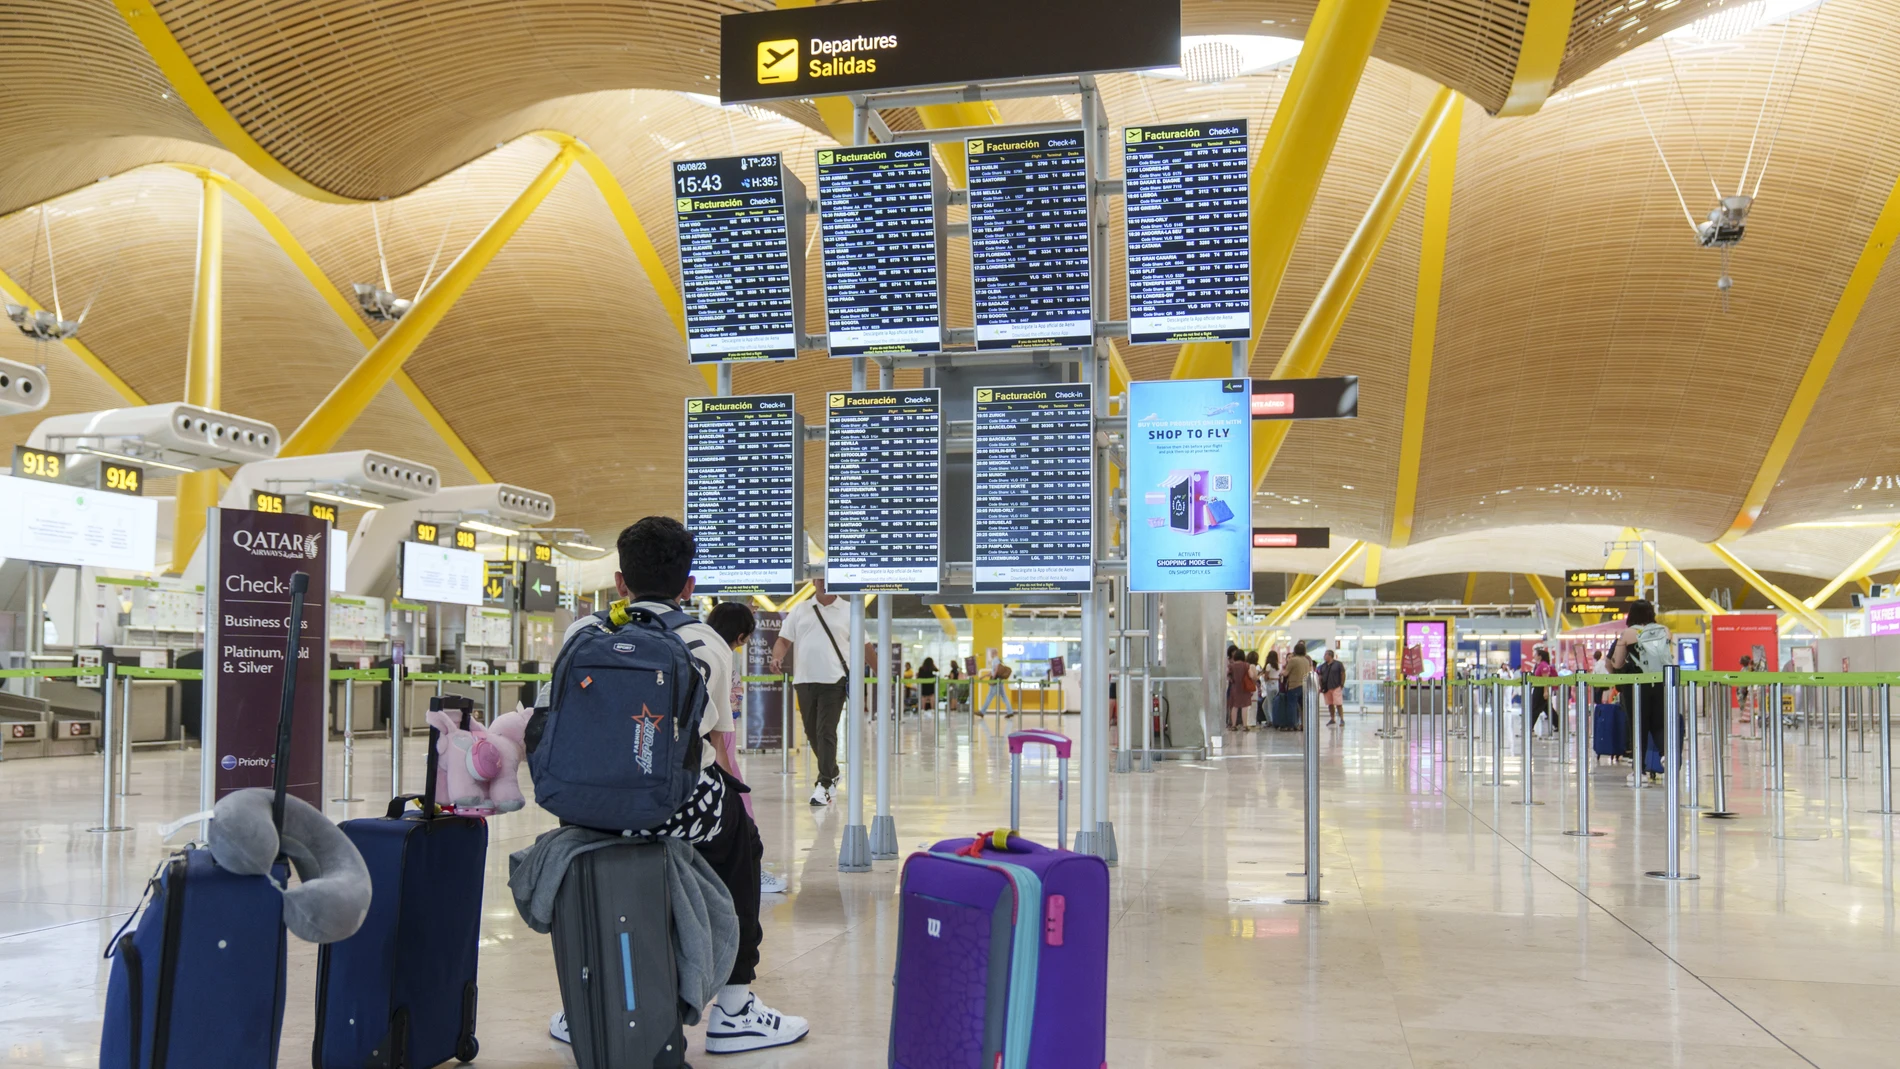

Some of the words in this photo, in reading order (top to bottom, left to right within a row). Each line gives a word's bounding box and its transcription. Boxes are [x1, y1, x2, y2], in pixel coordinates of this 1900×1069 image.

[811, 35, 897, 56] Departures
[809, 57, 876, 78] Salidas
[1145, 129, 1200, 140] Facturación
[1209, 127, 1238, 136] Check-in
[987, 140, 1039, 151] Facturación
[836, 151, 886, 162] Facturación
[895, 150, 922, 158] Check-in
[677, 162, 706, 171] 06/08/23
[678, 174, 722, 193] 15:43
[694, 199, 742, 209] Facturación
[847, 396, 896, 405] Facturación
[995, 391, 1046, 400] Facturación
[705, 402, 752, 411] Facturación
[1149, 430, 1182, 440] SHOP
[1187, 429, 1202, 438] TO
[1208, 428, 1230, 438] FLY
[23, 452, 59, 478] 913
[106, 467, 138, 491] 914
[257, 494, 282, 513] 915
[312, 504, 334, 522] 916
[417, 524, 436, 542] 917
[457, 530, 475, 548] 918
[233, 530, 303, 551] QATAR
[535, 545, 550, 561] 919
[226, 575, 291, 593] Check-
[1871, 610, 1881, 621] TAX
[1881, 608, 1895, 620] FREE
[225, 615, 280, 628] Business
[284, 617, 308, 628] Css
[224, 645, 284, 660] Platinum,
[298, 647, 309, 658] old
[223, 661, 234, 673] &
[238, 661, 273, 673] Silver
[749, 656, 764, 665] Bag
[239, 757, 269, 767] Priority
